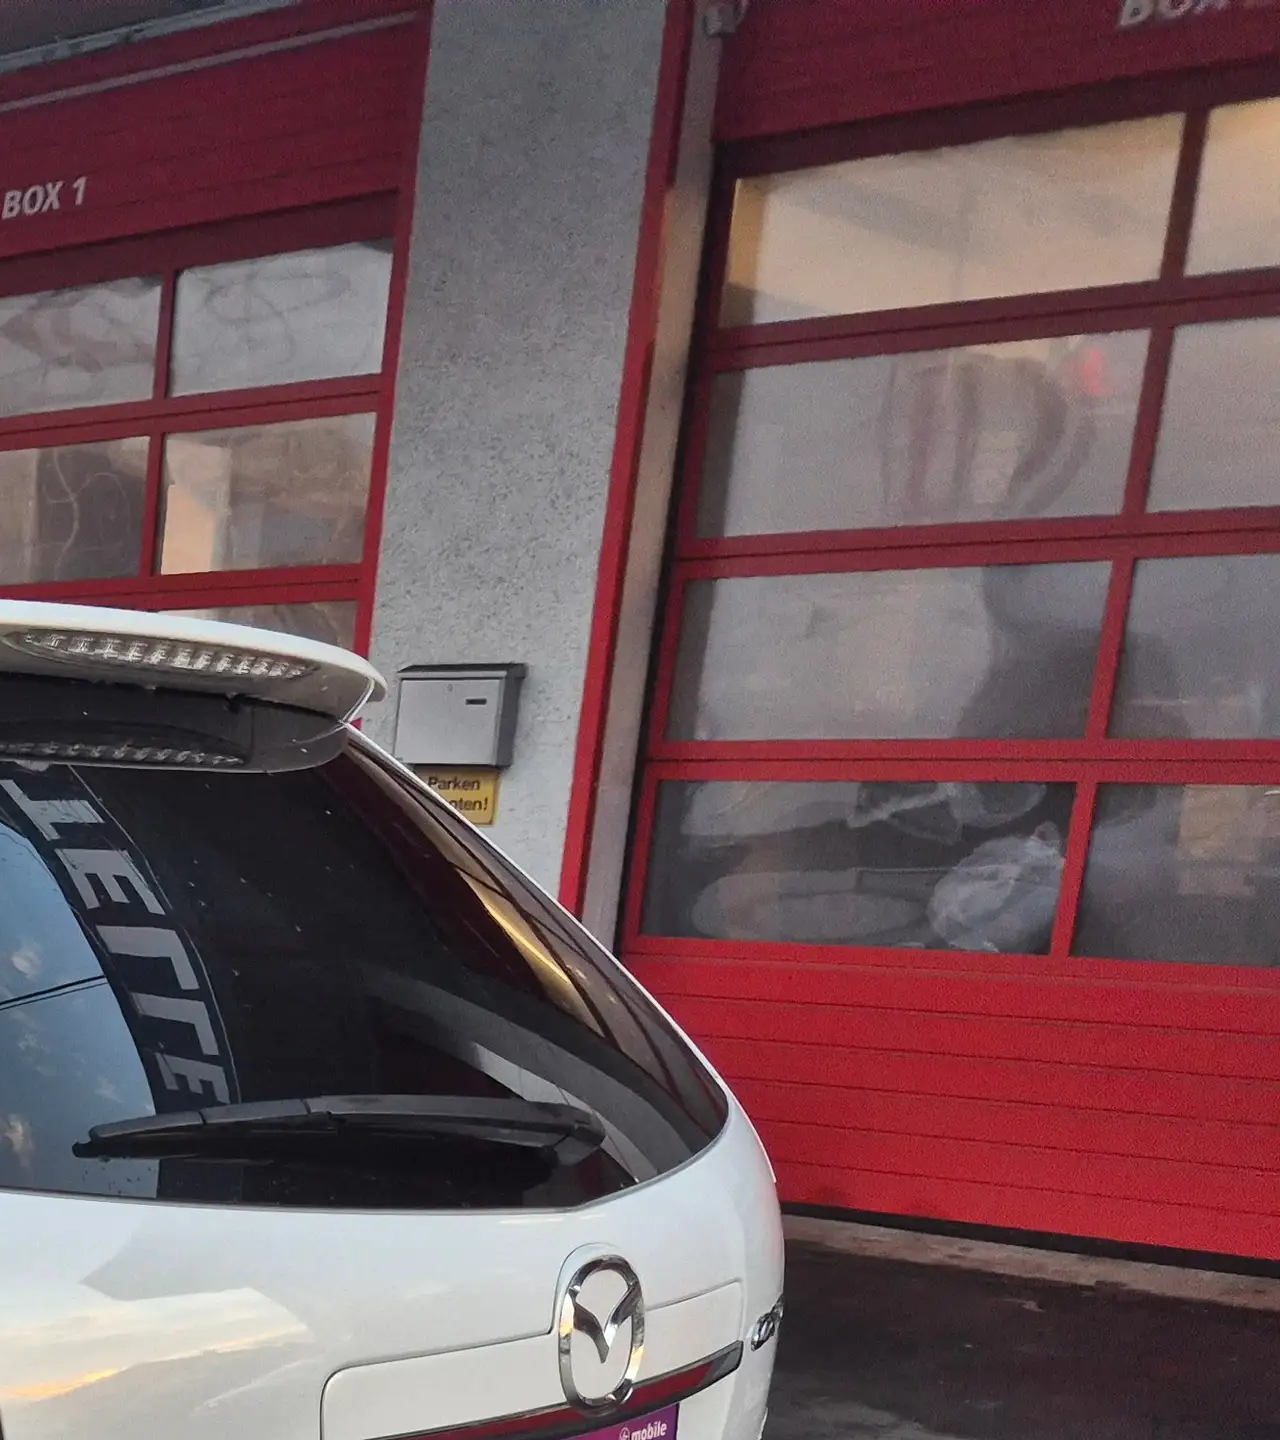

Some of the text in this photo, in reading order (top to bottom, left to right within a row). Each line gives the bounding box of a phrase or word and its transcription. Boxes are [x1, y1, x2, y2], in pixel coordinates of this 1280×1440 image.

[2, 176, 87, 220] BOX 1
[427, 776, 480, 791] Parken
